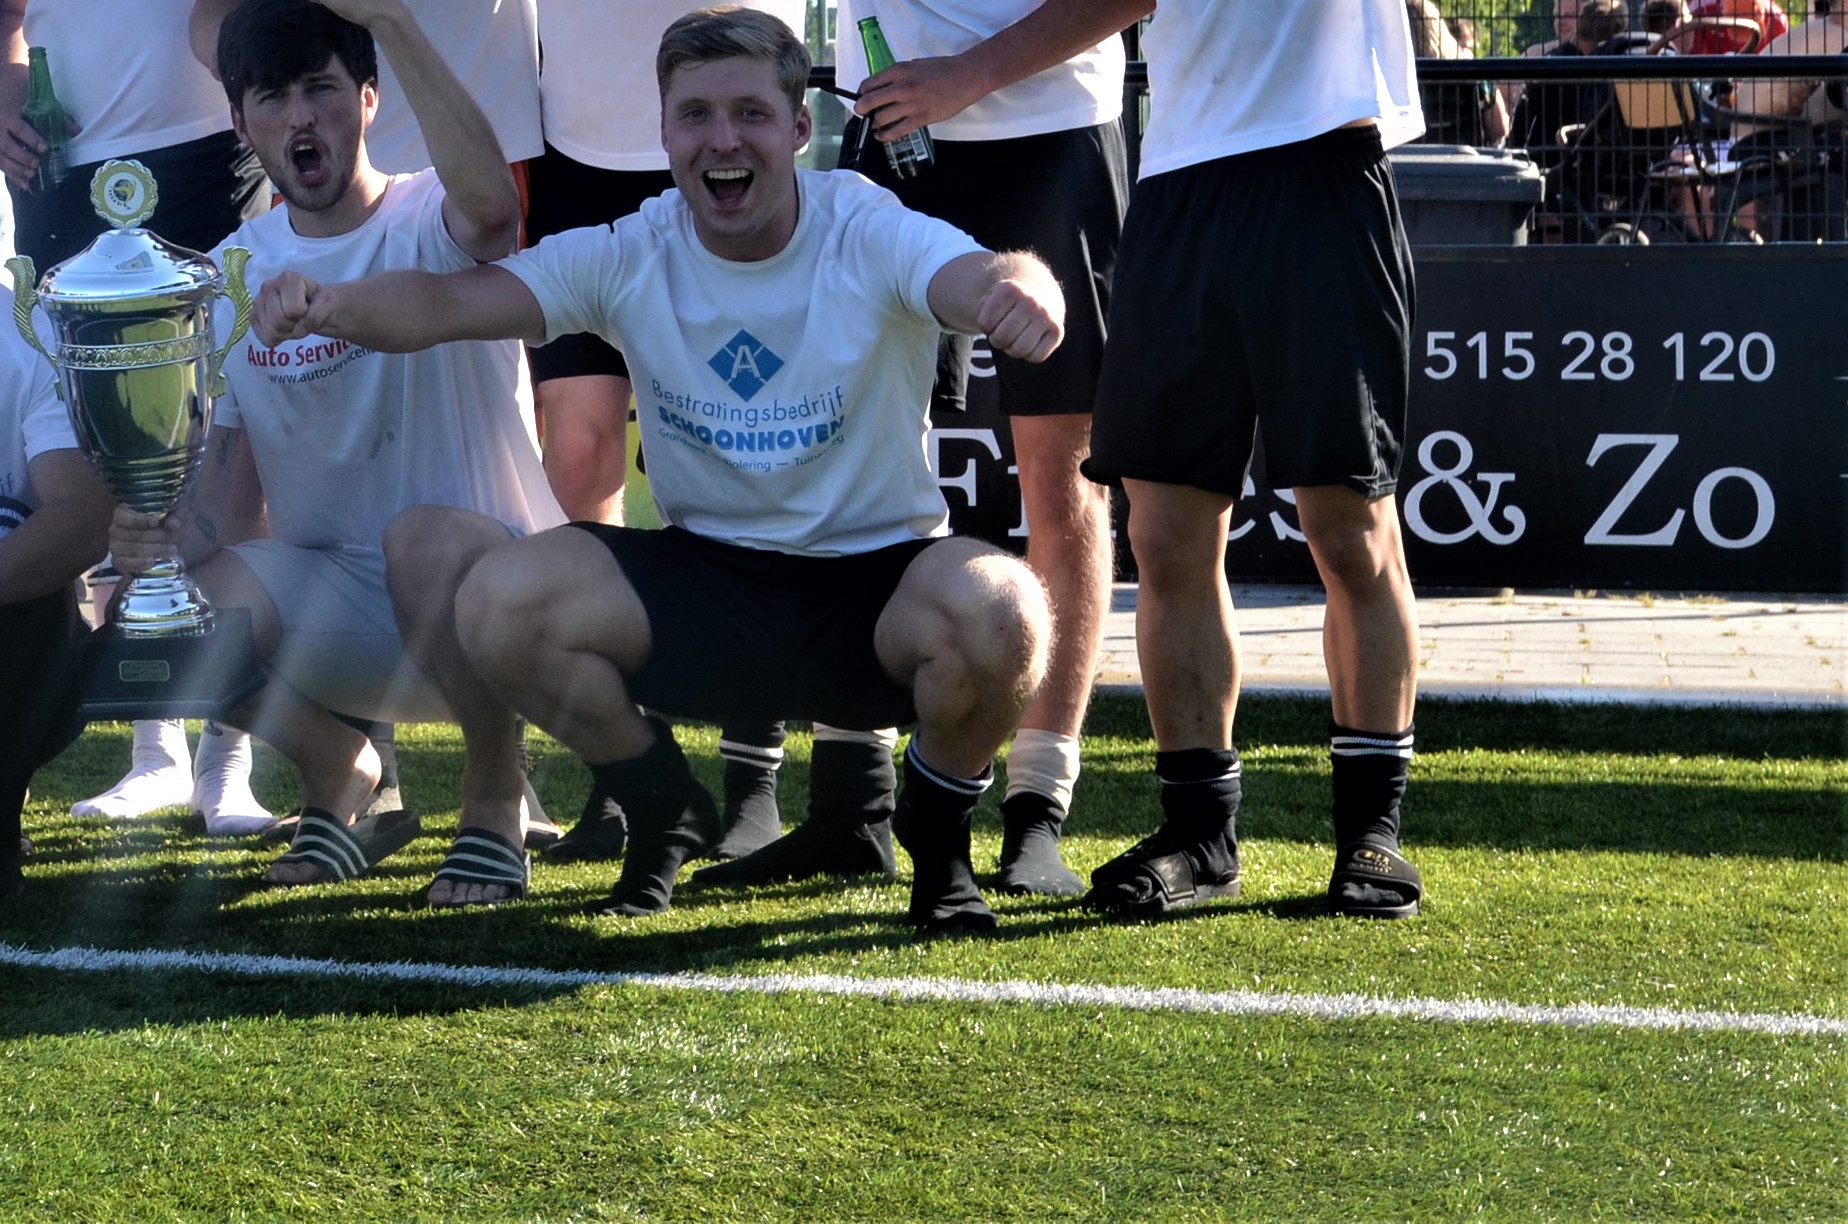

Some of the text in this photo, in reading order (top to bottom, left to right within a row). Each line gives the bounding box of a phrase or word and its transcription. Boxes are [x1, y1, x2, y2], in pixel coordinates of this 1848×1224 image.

[247, 344, 290, 367] Auto
[1424, 330, 1776, 382] 515 28 120
[652, 378, 843, 428] Bestratingsbedrijf
[1583, 433, 1776, 549] Zo
